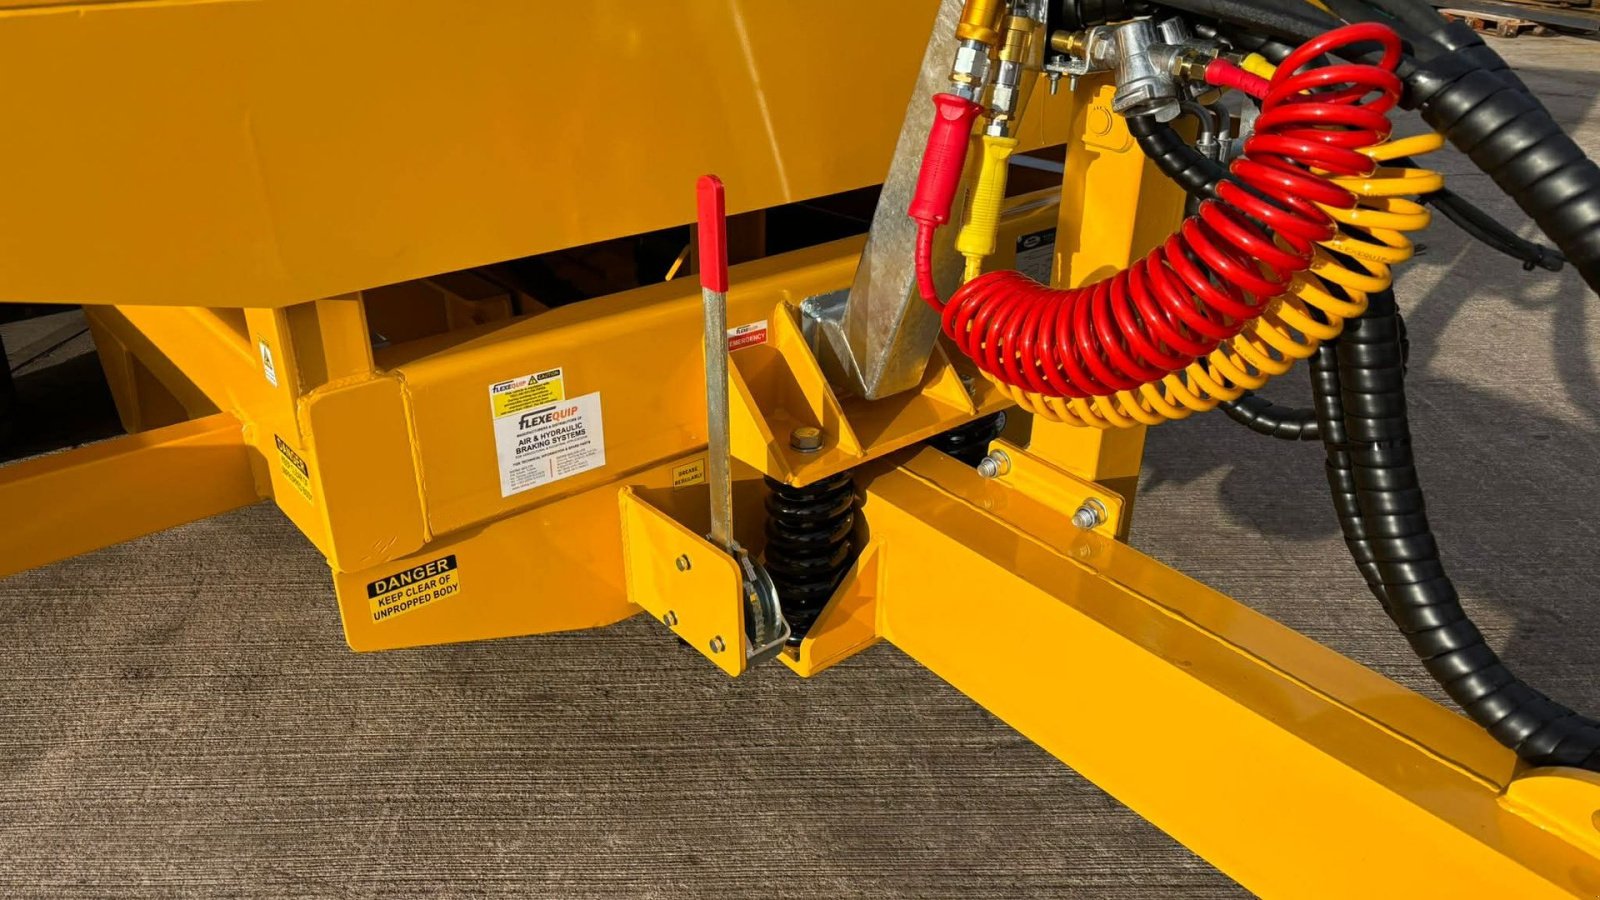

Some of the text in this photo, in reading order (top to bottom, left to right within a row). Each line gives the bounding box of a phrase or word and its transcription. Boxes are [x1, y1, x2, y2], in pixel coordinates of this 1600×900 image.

[729, 332, 766, 347] EMERGENCY
[516, 428, 585, 454] BRAKING SYSTEMS
[518, 436, 531, 446] AIR
[540, 421, 582, 439] HYDRAULIC
[375, 559, 449, 594] DANGER
[378, 574, 451, 607] KEEP CLEAR OF
[374, 583, 458, 621] UNPROPPED BODY
